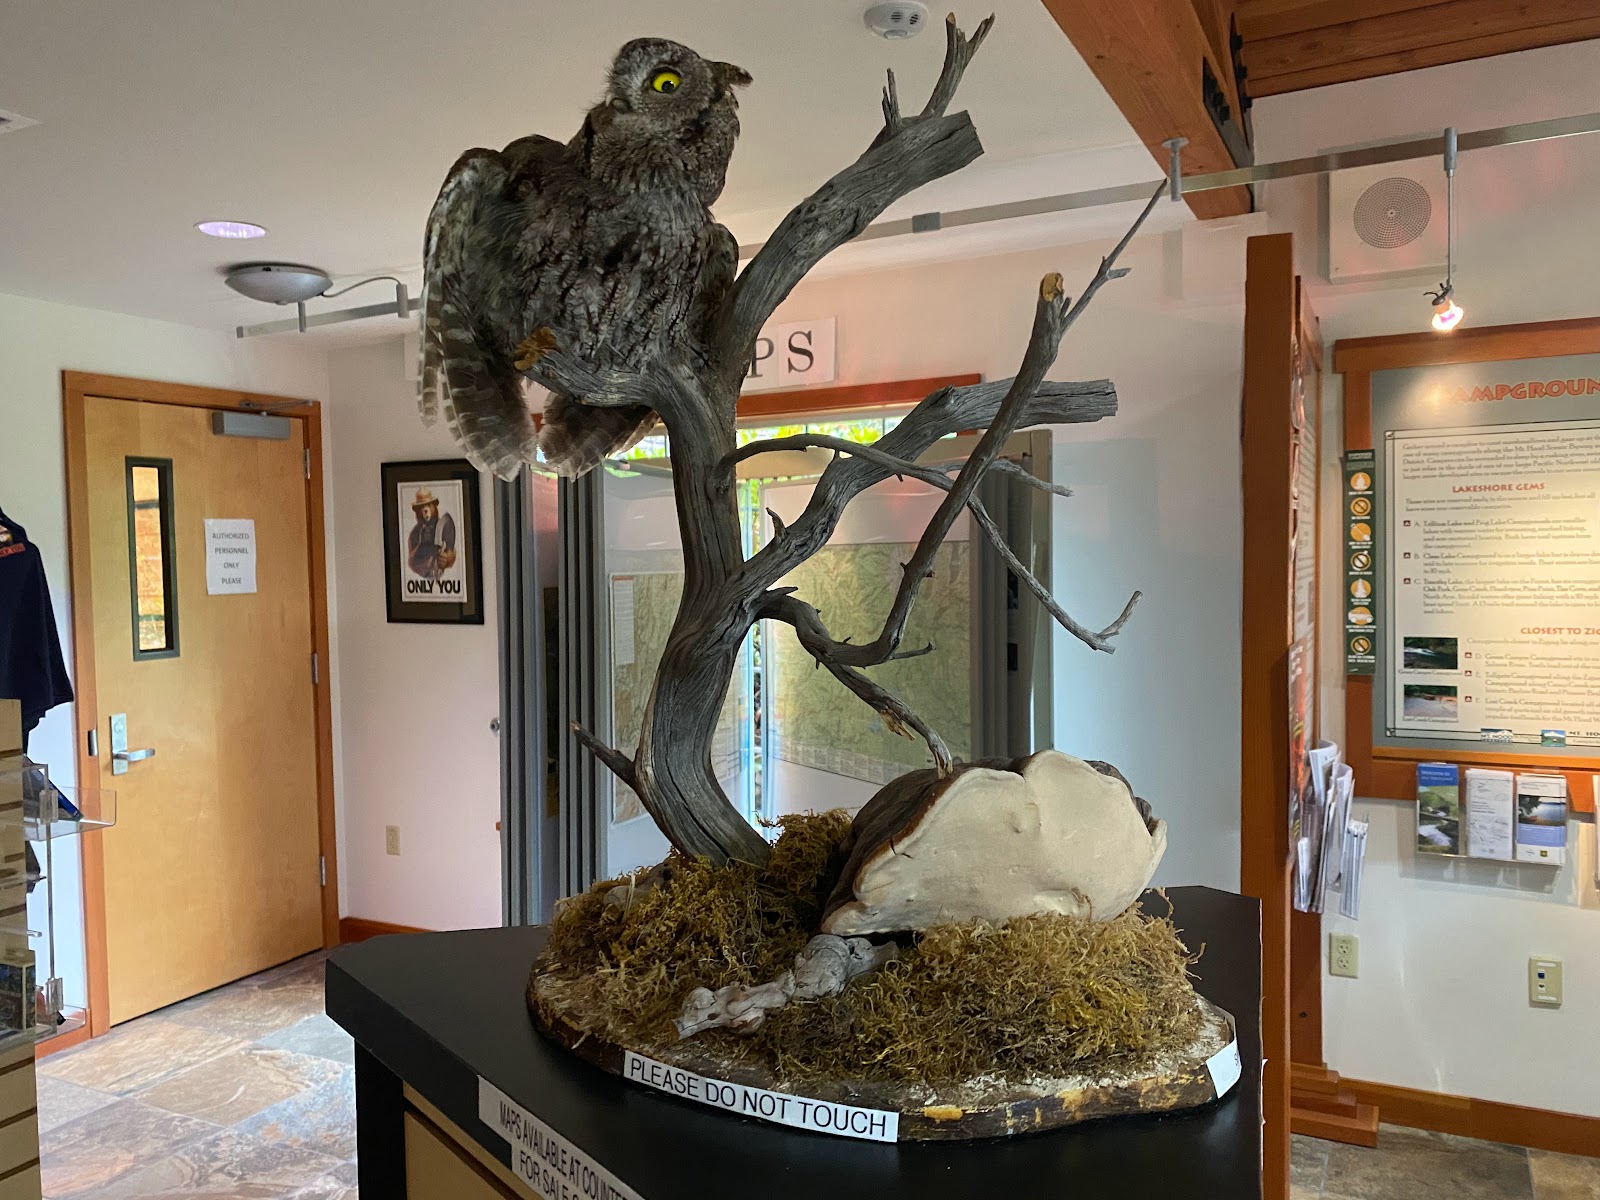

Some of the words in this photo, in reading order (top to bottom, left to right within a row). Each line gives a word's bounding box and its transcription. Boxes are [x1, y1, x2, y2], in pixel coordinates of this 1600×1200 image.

[746, 330, 814, 379] PS
[1449, 378, 1600, 403] AMPGROUN
[1452, 484, 1513, 493] LAKESHORE
[1516, 482, 1545, 490] GEMS
[407, 580, 434, 594] ONLY
[438, 580, 460, 594] YOU
[630, 1058, 700, 1098] PLEASE
[706, 1082, 736, 1107] DO
[743, 1090, 791, 1119] NOT
[798, 1102, 886, 1136] TOUCH
[500, 1101, 522, 1140] MAPS
[523, 1120, 567, 1177] AVAILABLE
[569, 1156, 580, 1188] AT
[520, 1150, 540, 1186] FOR
